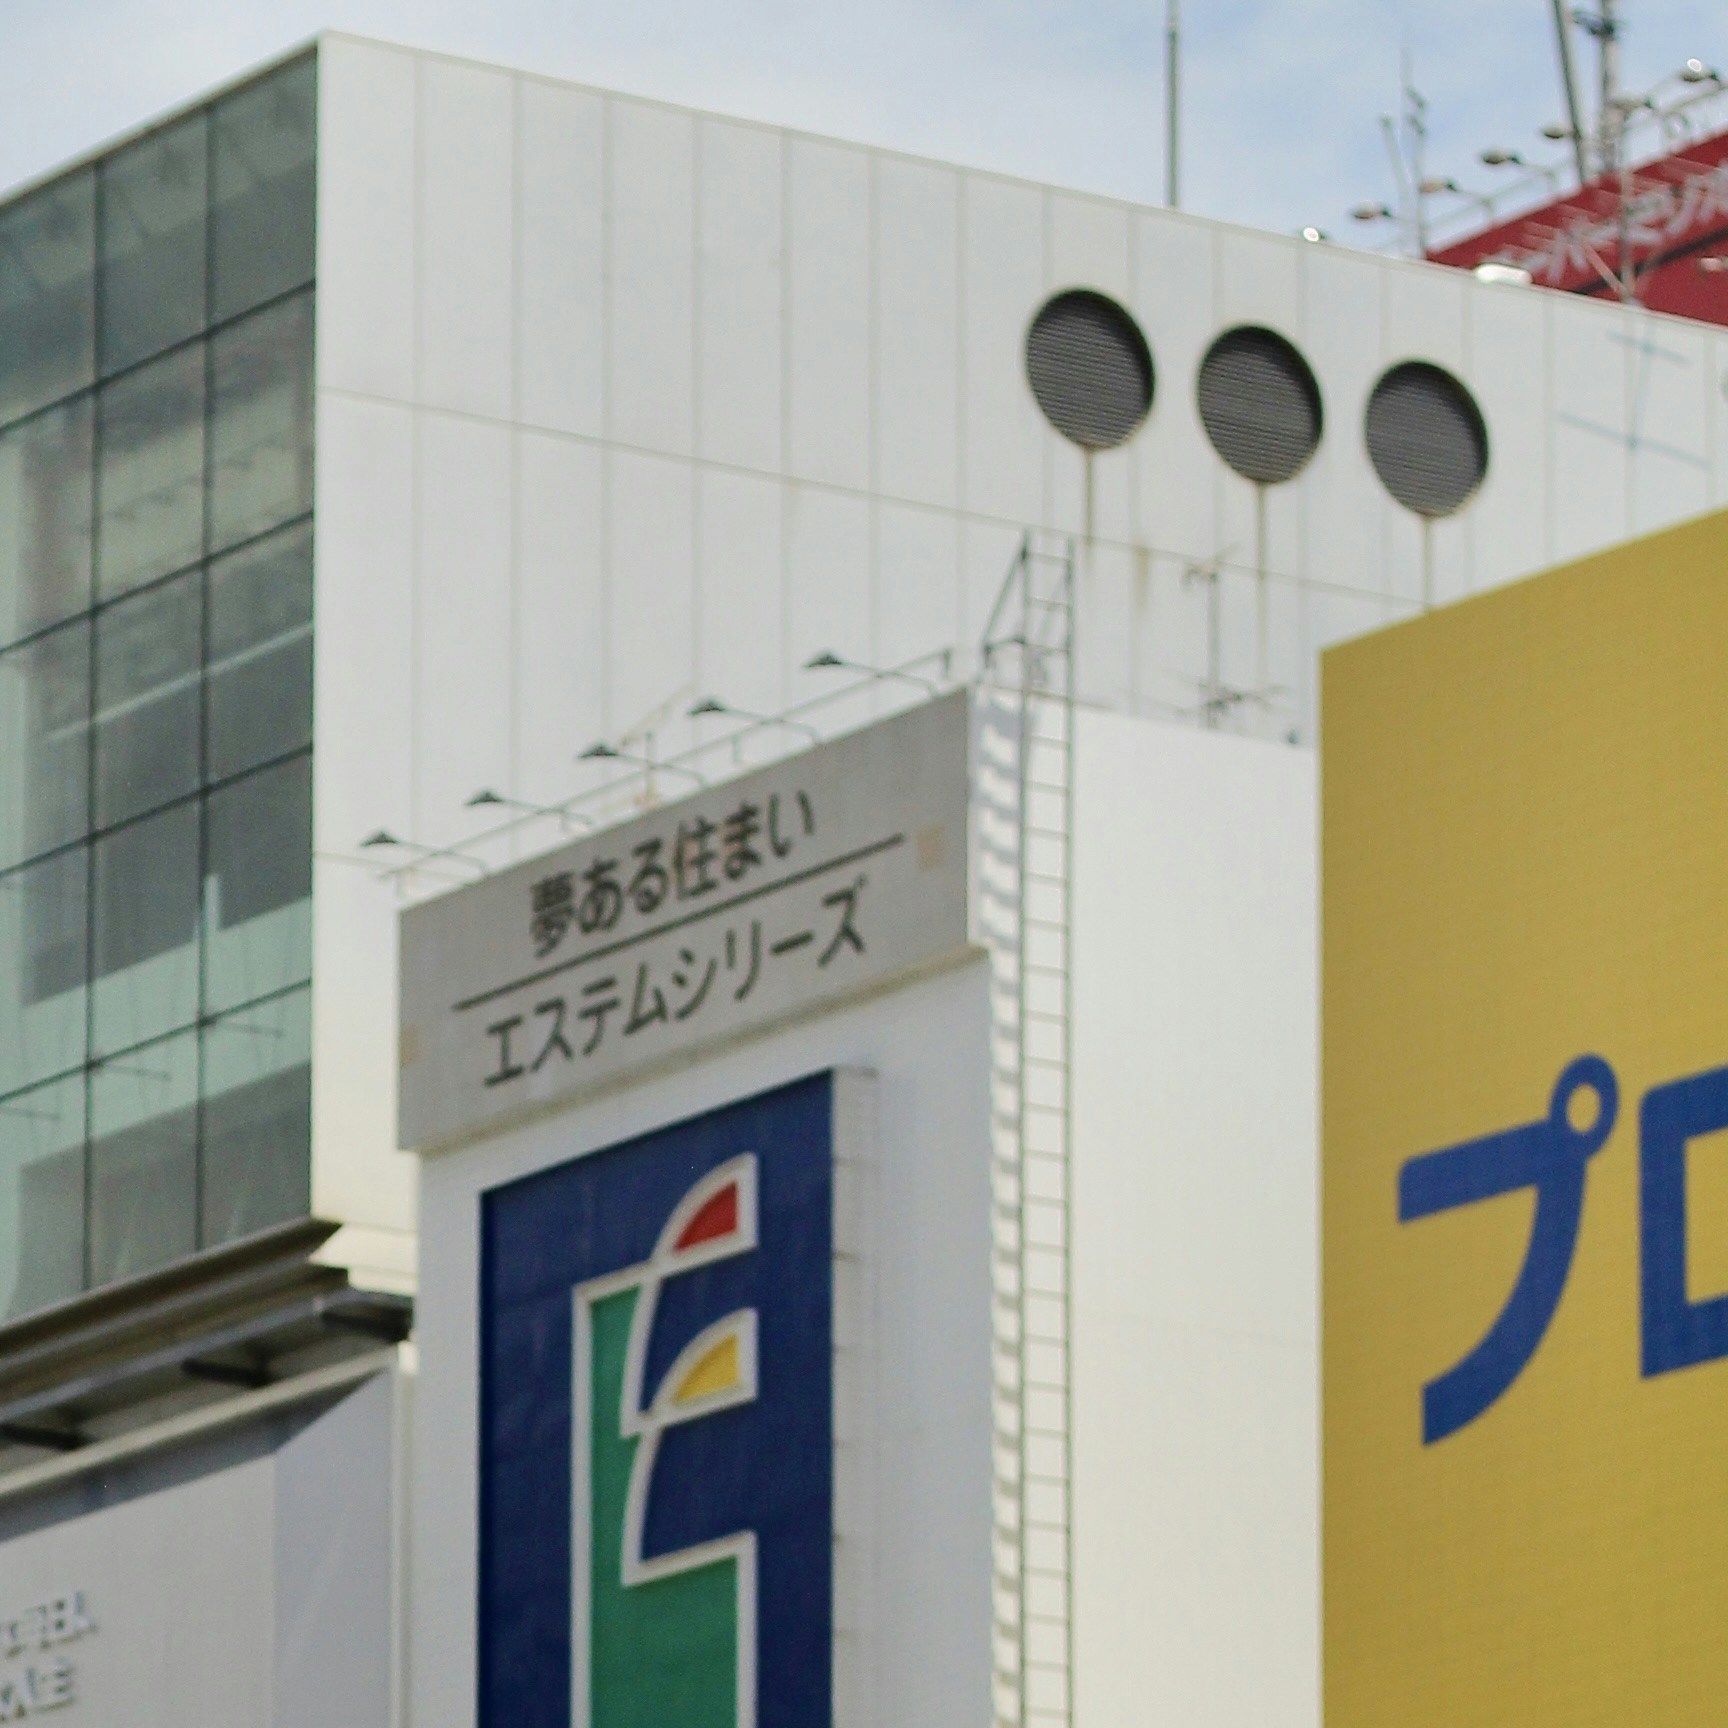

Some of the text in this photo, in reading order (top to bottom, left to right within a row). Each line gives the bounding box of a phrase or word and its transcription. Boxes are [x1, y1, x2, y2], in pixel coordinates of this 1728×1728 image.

[529, 789, 815, 957] 夢ある住まい
[483, 874, 868, 1087] エステムシリーズ
